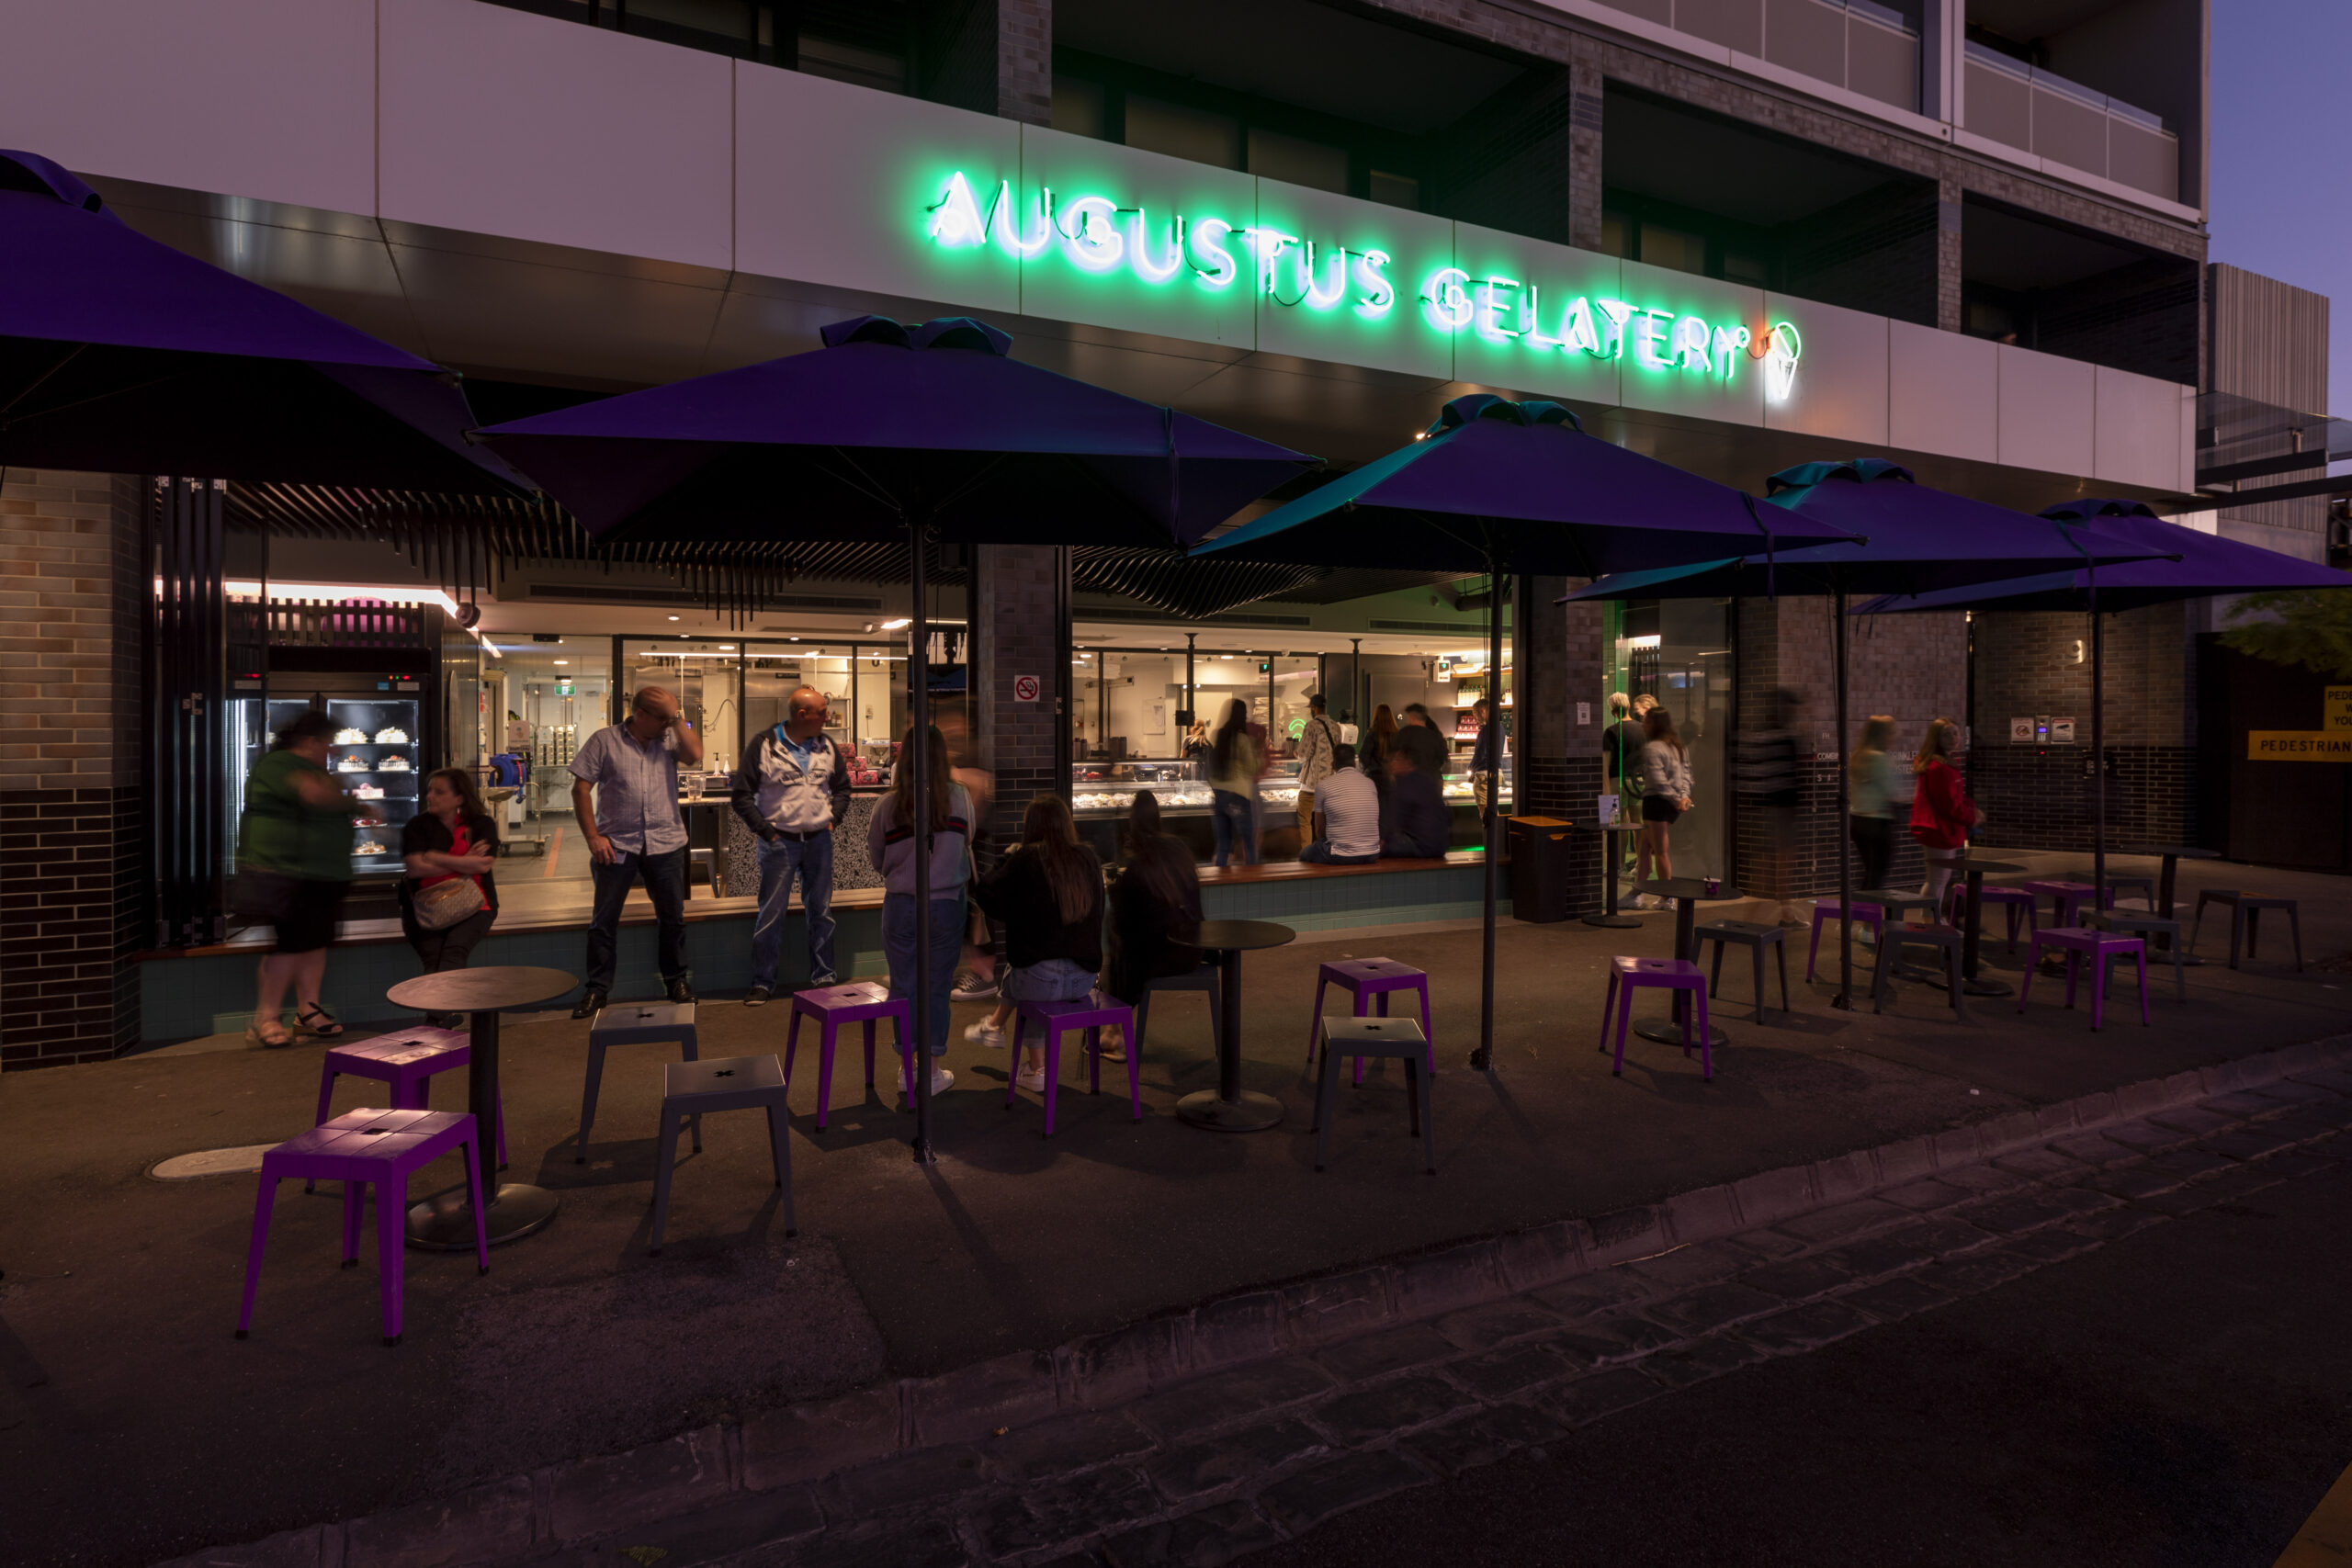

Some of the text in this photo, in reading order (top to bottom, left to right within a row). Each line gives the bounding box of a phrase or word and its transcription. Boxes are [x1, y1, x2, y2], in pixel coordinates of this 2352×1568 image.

[932, 171, 1751, 379] AUGUSTUS GELATERY
[2260, 739, 2352, 752] PEDESTRIAN
